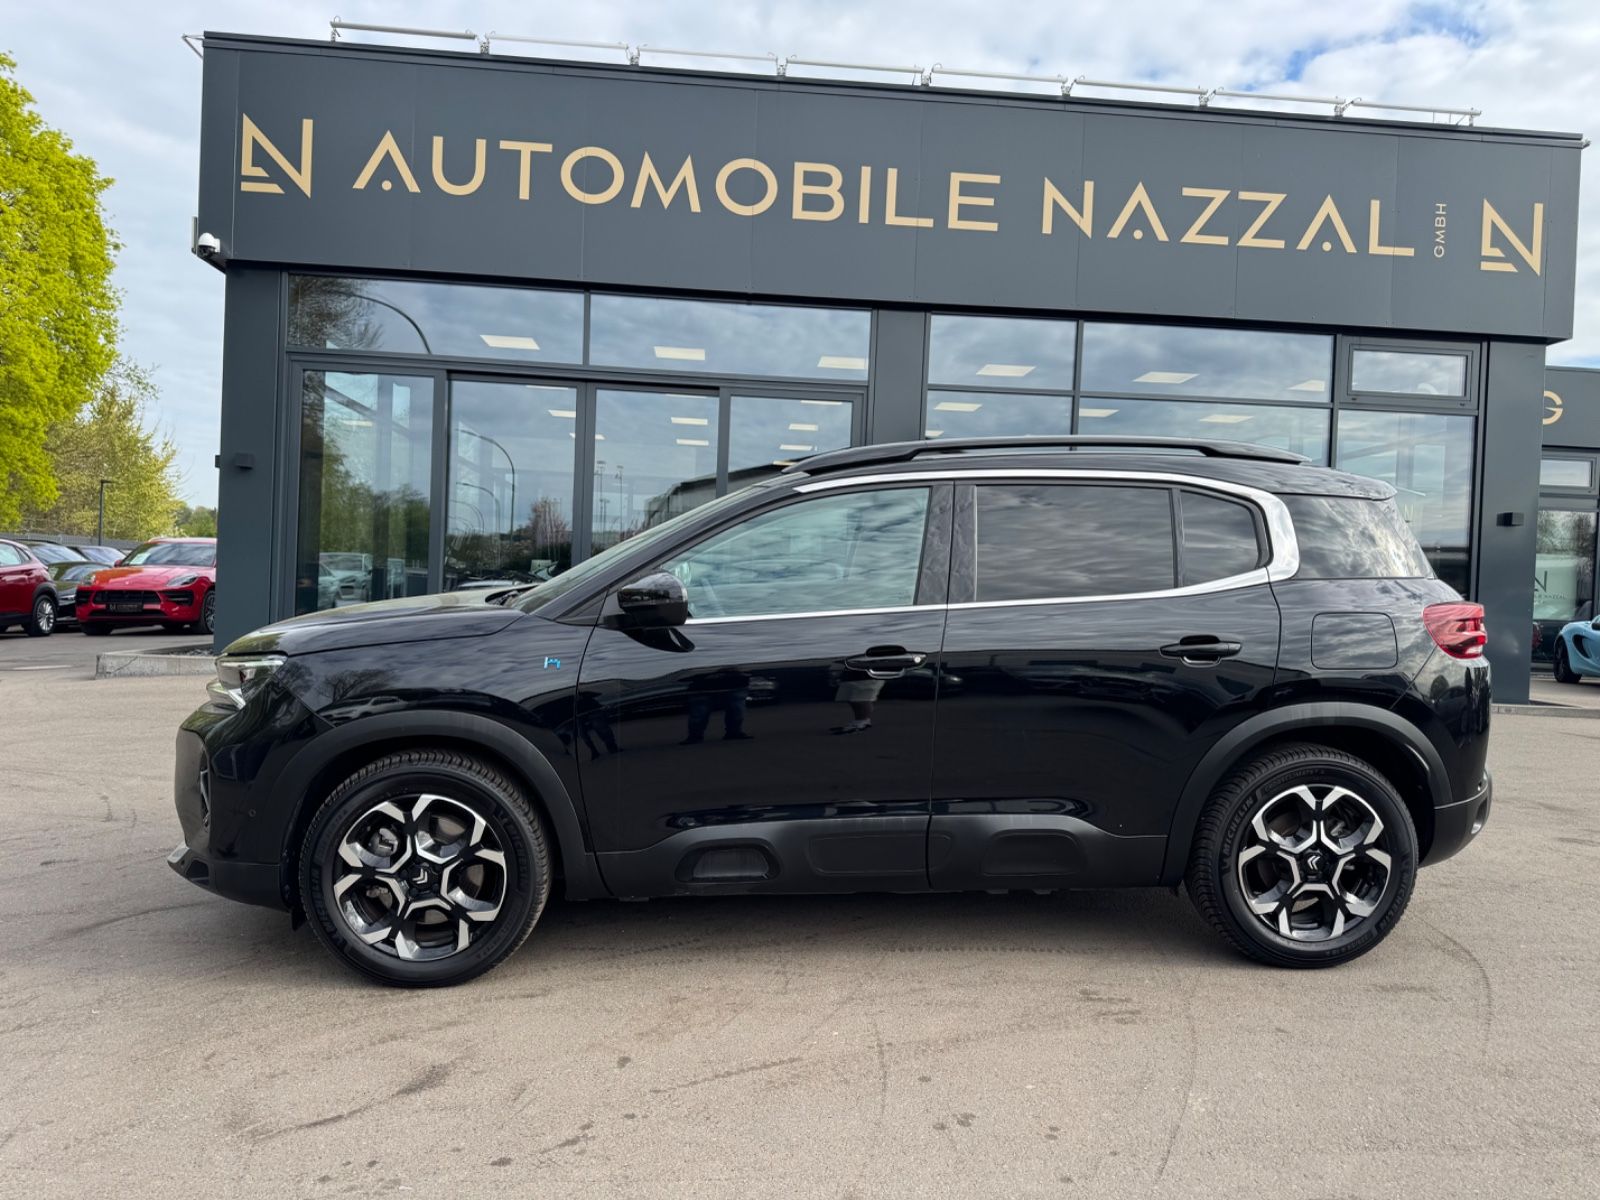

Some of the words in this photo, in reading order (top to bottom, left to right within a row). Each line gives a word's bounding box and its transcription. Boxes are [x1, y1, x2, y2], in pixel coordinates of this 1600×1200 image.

[352, 131, 1001, 235] AUTOMOBILE
[1041, 178, 1416, 259] NAZZAL
[1433, 202, 1448, 259] GMBH
[1222, 795, 1256, 857] MICHELIN
